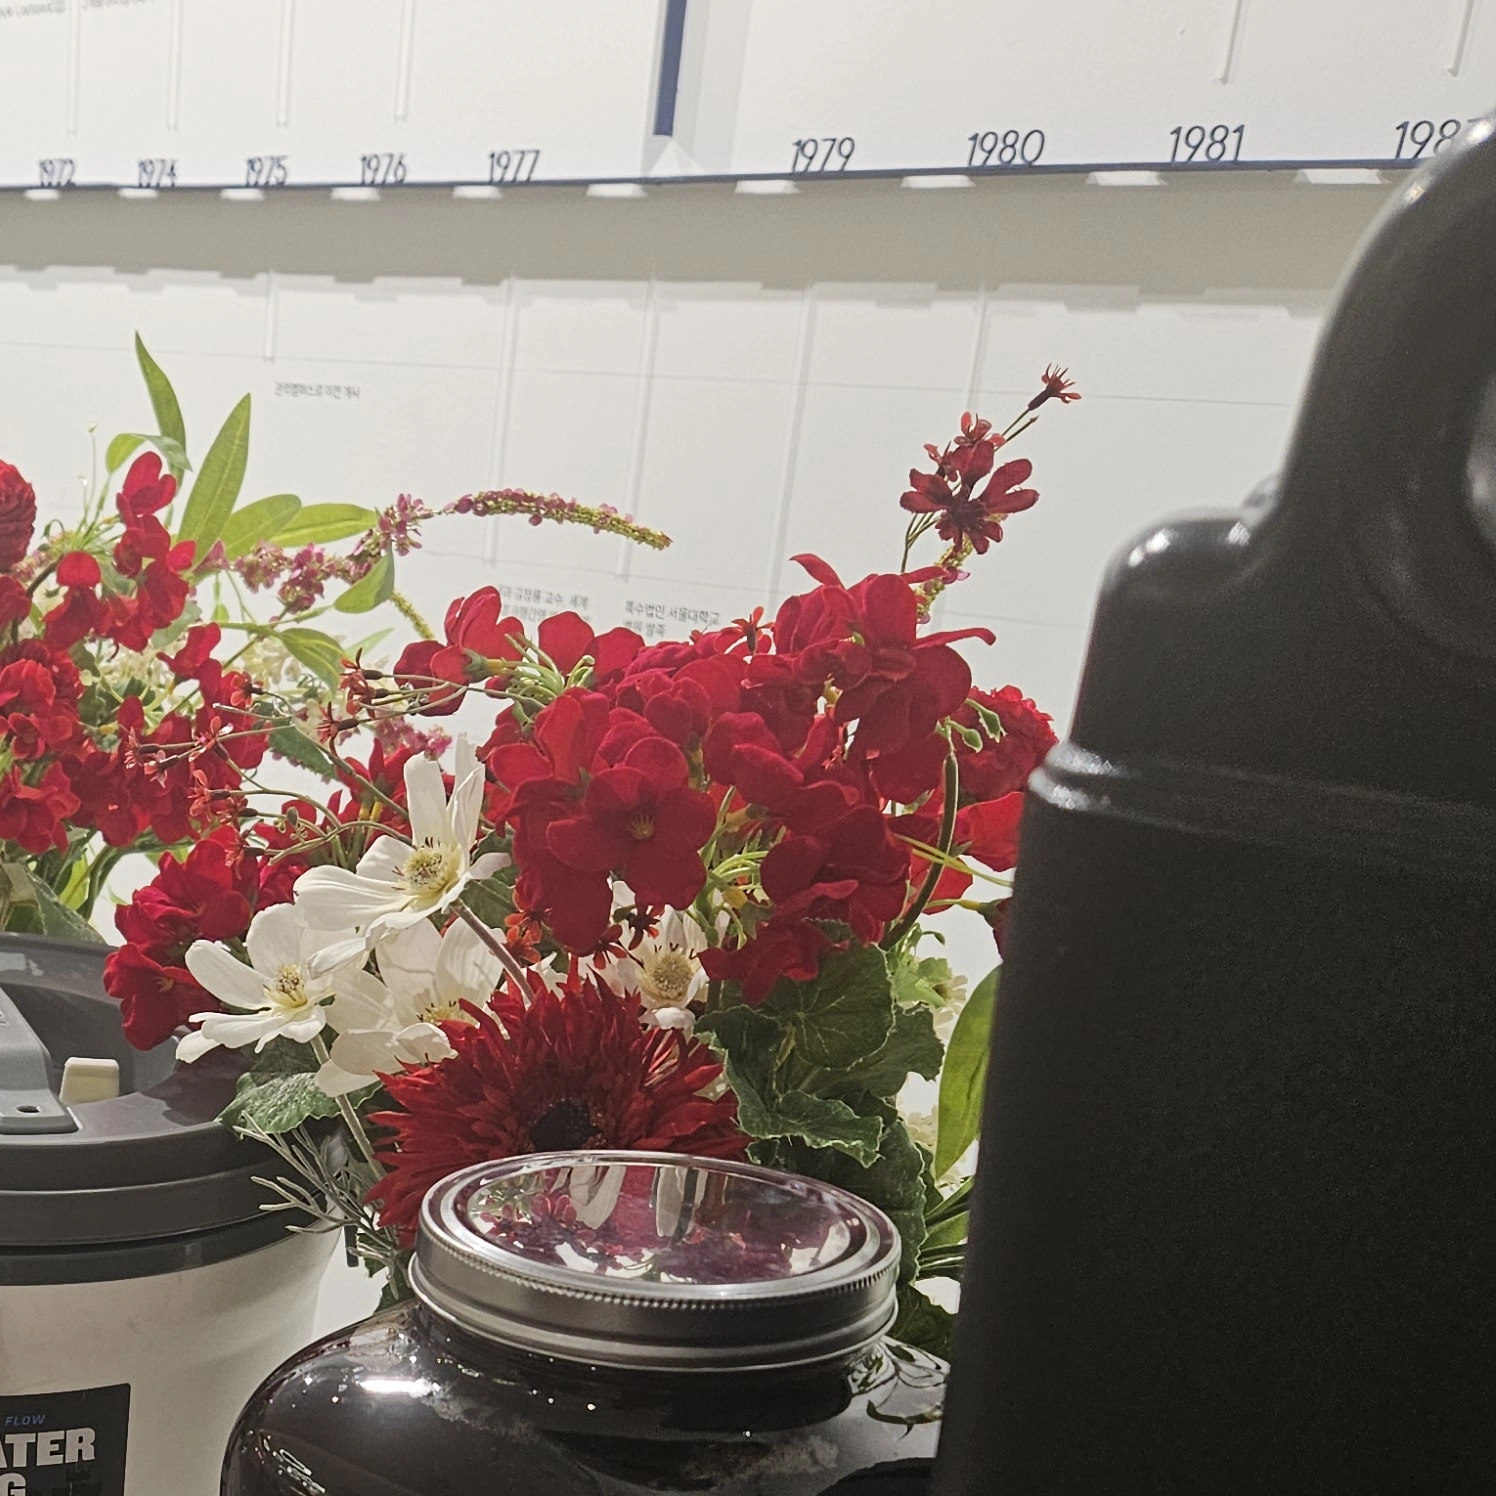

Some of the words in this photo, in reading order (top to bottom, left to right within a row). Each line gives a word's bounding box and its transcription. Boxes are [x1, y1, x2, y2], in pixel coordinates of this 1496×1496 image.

[965, 129, 1045, 168] 1980
[1169, 124, 1247, 163] 1981
[1395, 117, 1489, 160] 198
[245, 155, 288, 186] 1975
[360, 152, 407, 185] 1976
[489, 149, 540, 183] 1977
[790, 137, 856, 174] 1979
[138, 159, 177, 187] 1974
[625, 600, 664, 620] 특수법인
[668, 606, 720, 625] 서울대학교
[4, 1414, 46, 1426] FLOW
